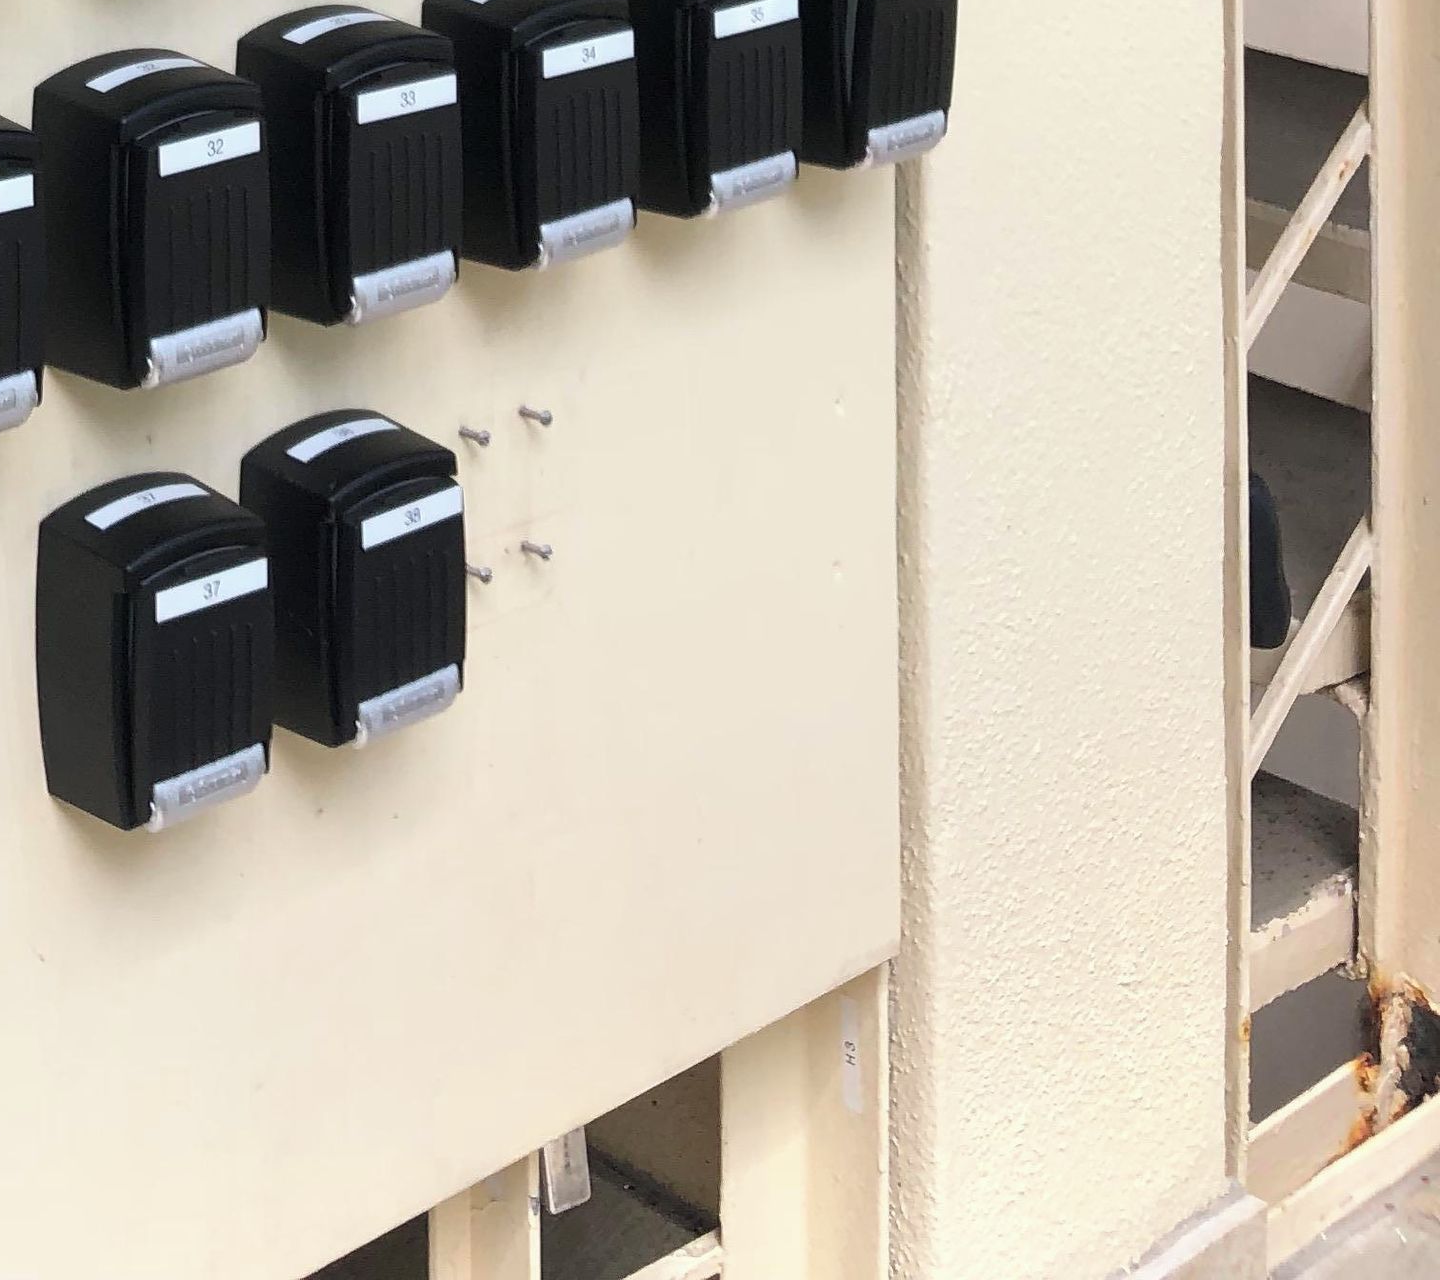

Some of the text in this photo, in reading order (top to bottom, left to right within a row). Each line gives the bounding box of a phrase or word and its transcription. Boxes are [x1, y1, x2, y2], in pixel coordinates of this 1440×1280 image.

[399, 90, 416, 108] 33
[207, 138, 224, 158] 32
[203, 579, 221, 601] 37
